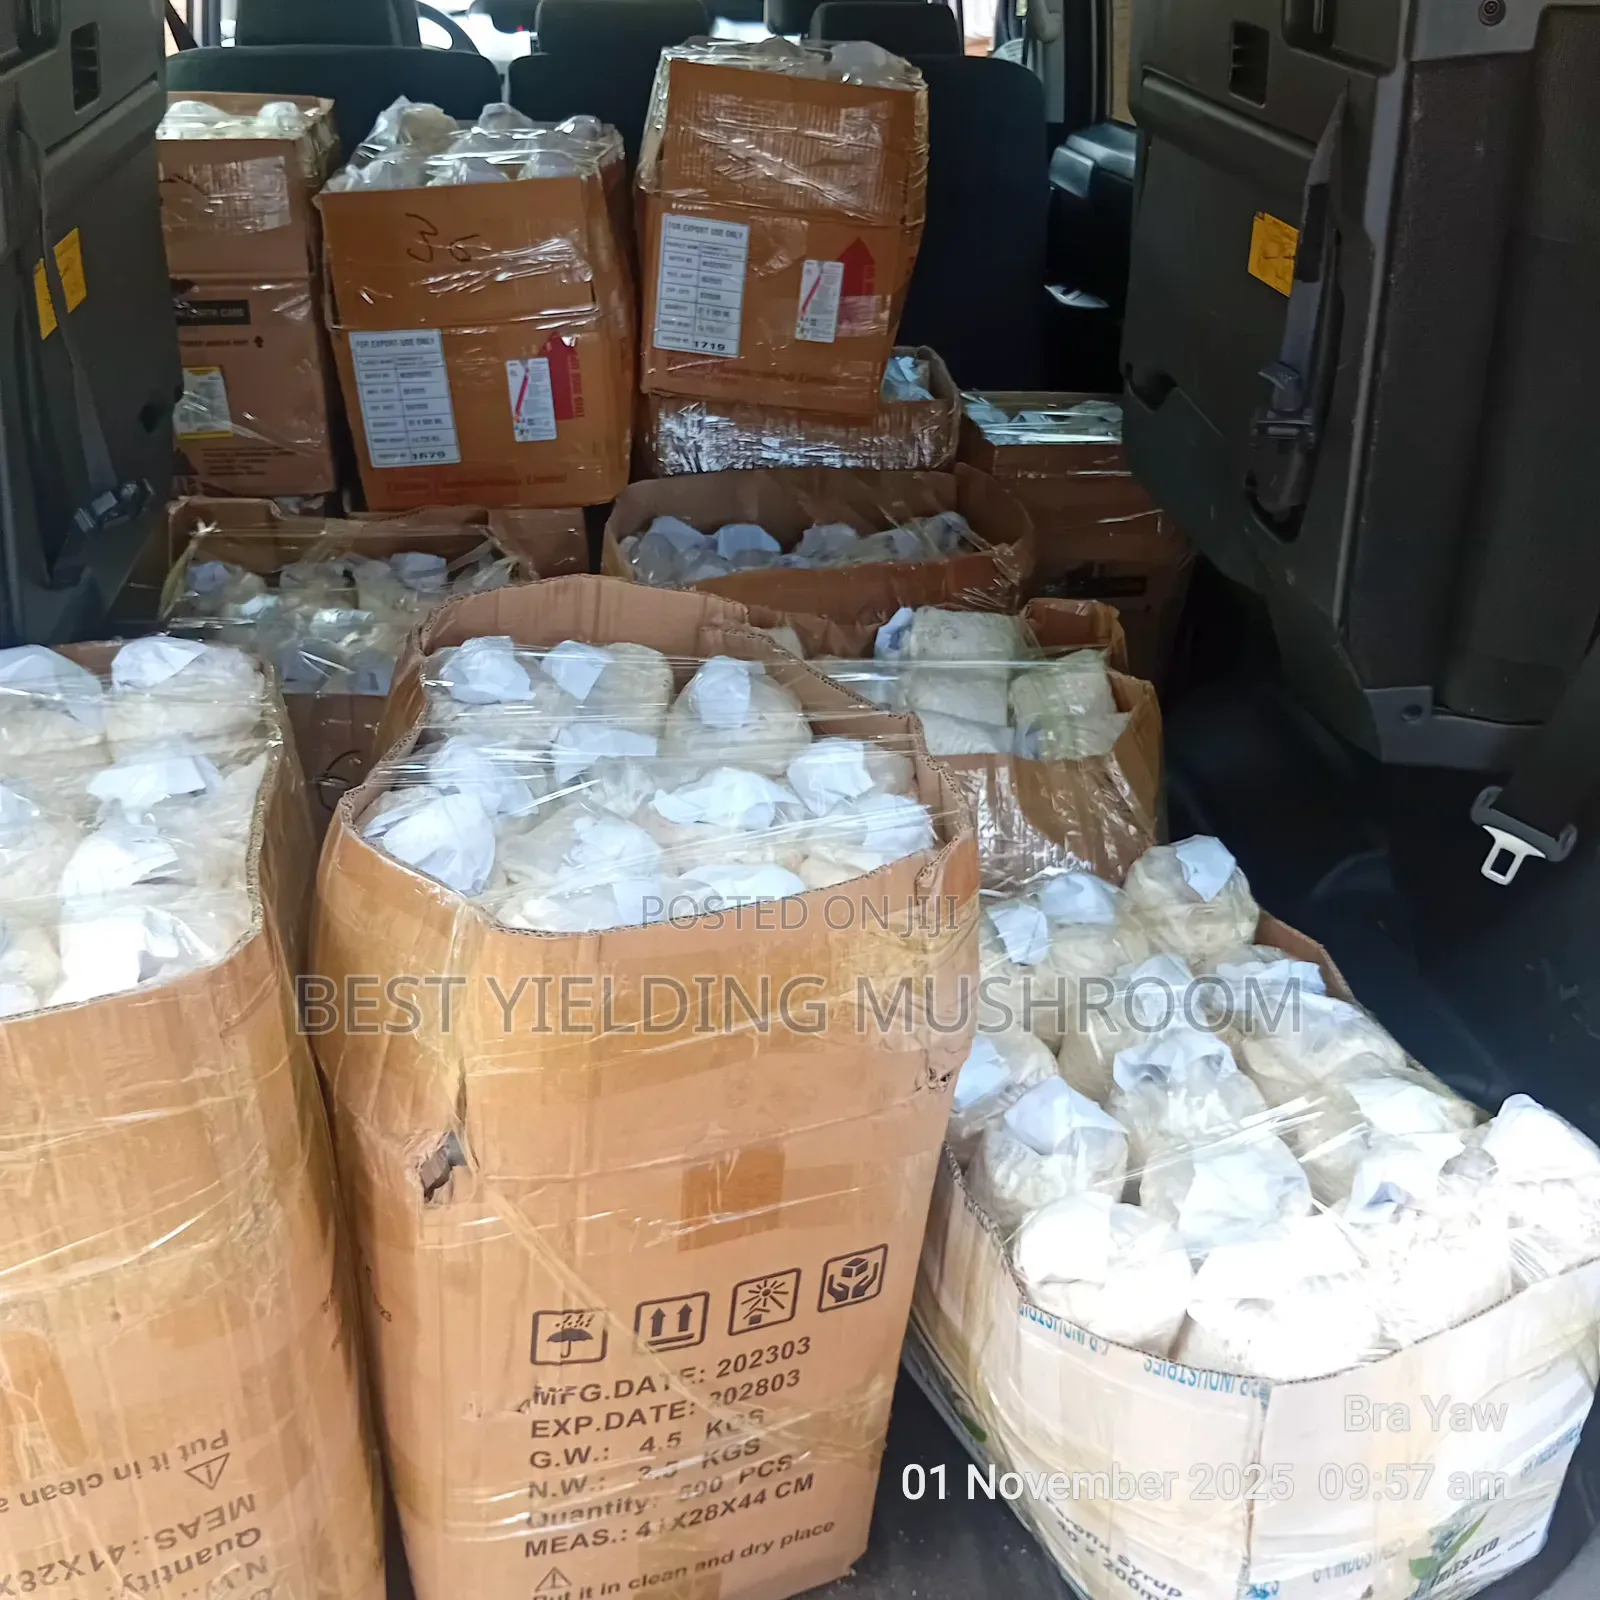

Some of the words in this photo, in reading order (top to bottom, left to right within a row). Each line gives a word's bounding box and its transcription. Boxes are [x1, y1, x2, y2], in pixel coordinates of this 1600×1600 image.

[683, 224, 709, 235] EXPORT
[710, 228, 724, 238] USE
[725, 230, 744, 241] ONLY
[371, 339, 398, 349] EXPORT
[693, 341, 726, 352] 1719
[716, 1336, 810, 1379] 202303
[531, 1400, 695, 1438] EXP.DATE:
[709, 1369, 800, 1408] 202803
[149, 1451, 170, 1472] it
[177, 1429, 229, 1461] Put
[529, 1446, 609, 1469] G.W.:
[639, 1432, 682, 1453] 4.5
[113, 1461, 143, 1479] in
[528, 1476, 605, 1499] N.W.:
[702, 1438, 760, 1469] KGS
[20, 1473, 104, 1507] clean
[526, 1496, 658, 1529] Quantity:
[738, 1454, 793, 1485] PCS
[525, 1528, 627, 1558] MEAS.:
[775, 1472, 814, 1499] CM
[580, 1586, 593, 1599] it
[600, 1582, 621, 1596] in
[628, 1566, 688, 1590] clean
[695, 1549, 734, 1572] and
[740, 1539, 775, 1563] dry
[780, 1519, 836, 1549] place
[1102, 1556, 1172, 1600] 200m
[1117, 1553, 1184, 1599] Syrup
